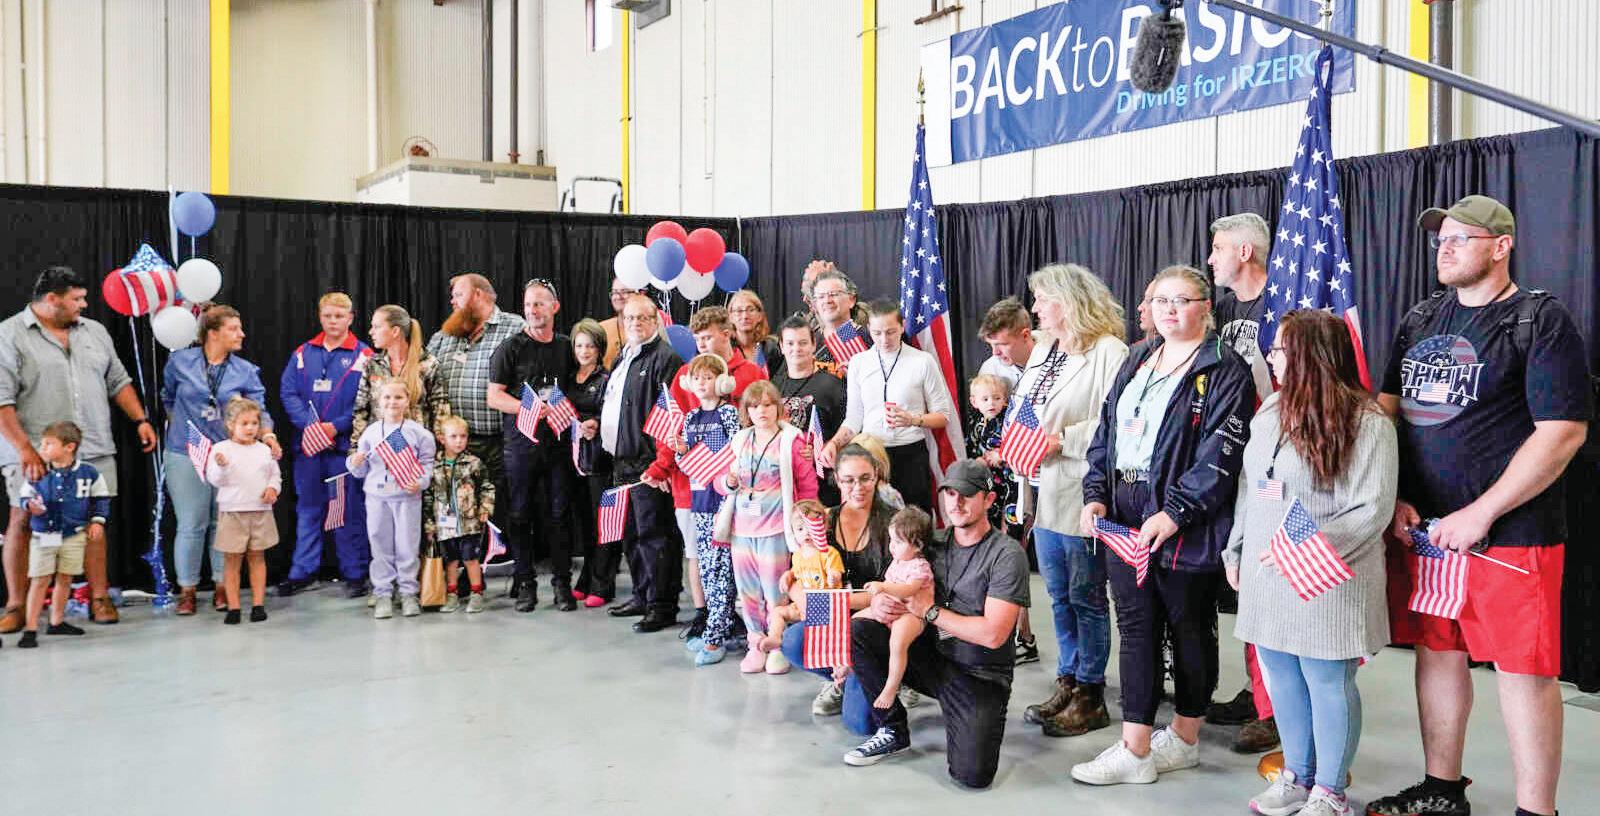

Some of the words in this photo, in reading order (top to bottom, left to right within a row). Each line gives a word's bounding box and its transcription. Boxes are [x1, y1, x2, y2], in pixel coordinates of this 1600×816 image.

[1116, 82, 1188, 114] Driving
[1193, 73, 1226, 98] for
[76, 478, 92, 498] H
